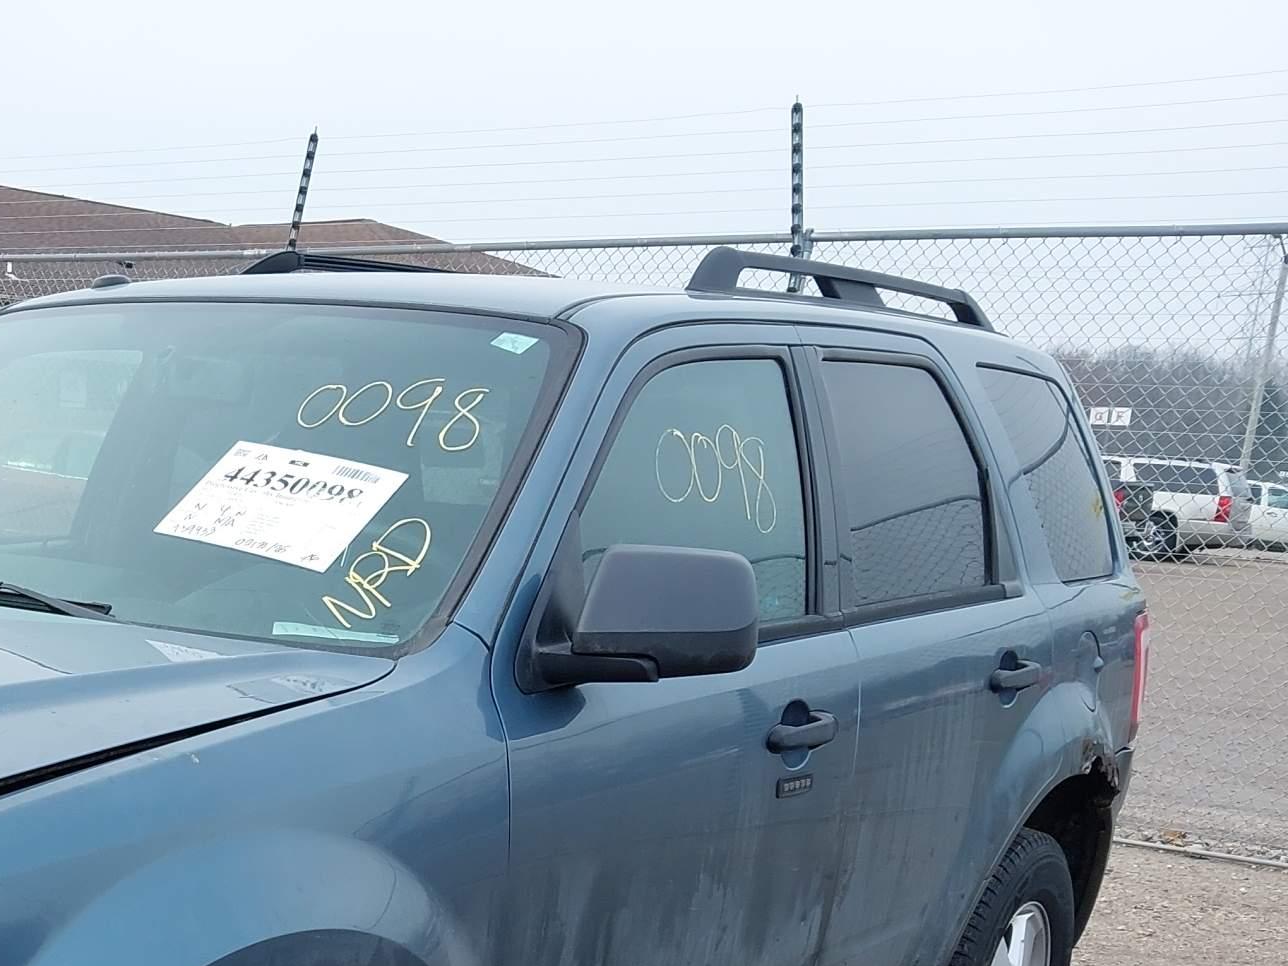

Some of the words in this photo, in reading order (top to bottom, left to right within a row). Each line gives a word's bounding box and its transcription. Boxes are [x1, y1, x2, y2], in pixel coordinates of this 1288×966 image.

[297, 377, 490, 452] 0098
[224, 465, 365, 505] 44350098
[655, 424, 777, 534] 0098
